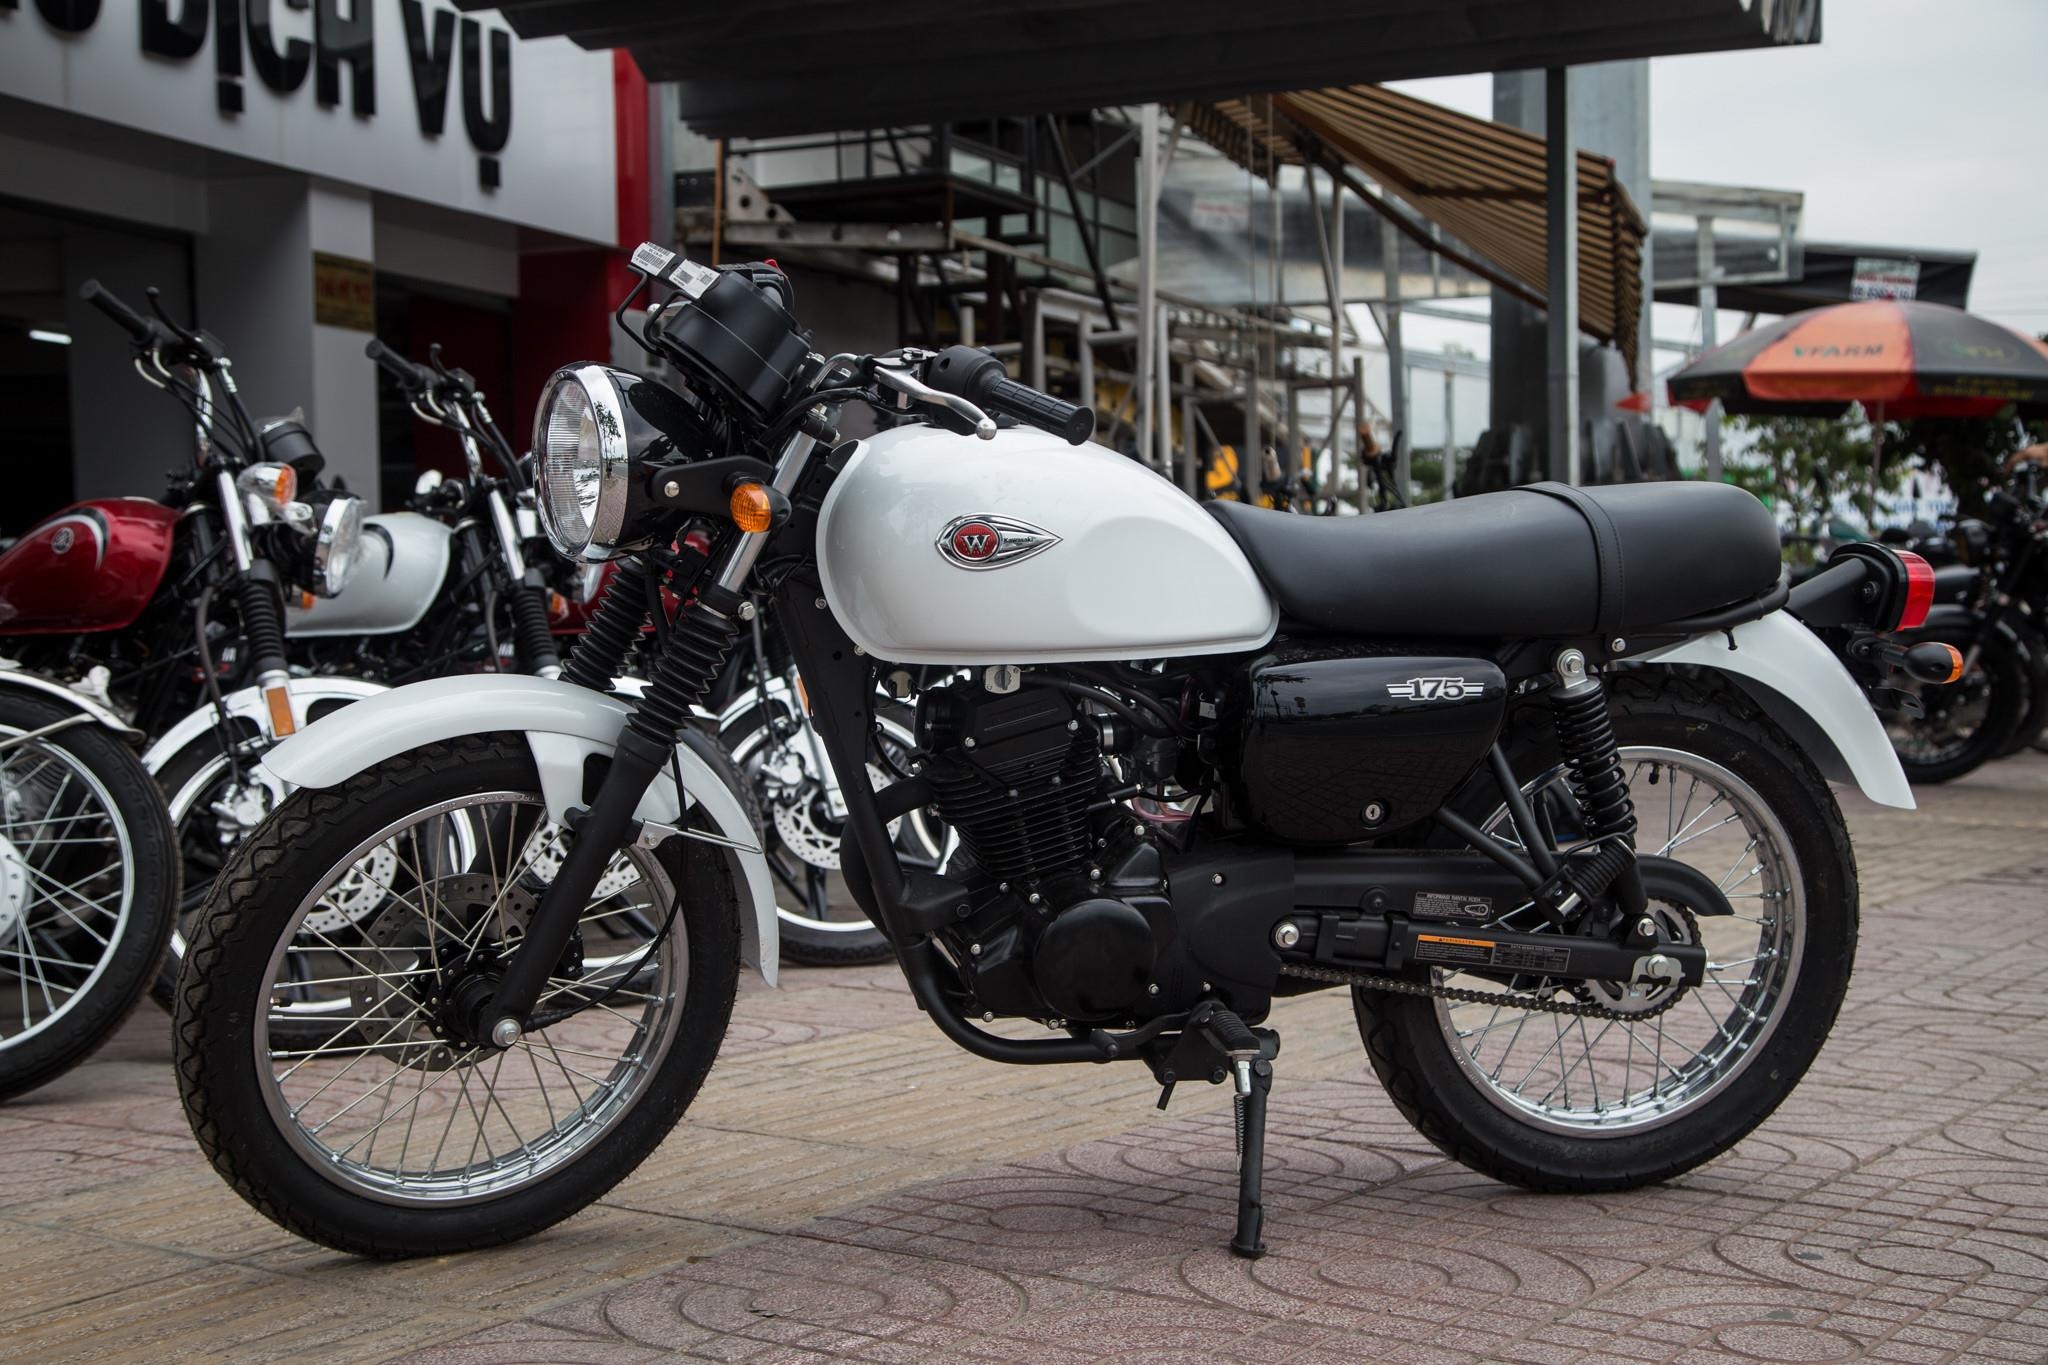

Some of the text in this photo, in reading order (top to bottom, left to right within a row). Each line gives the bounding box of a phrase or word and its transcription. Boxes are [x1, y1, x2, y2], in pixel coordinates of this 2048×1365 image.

[402, 0, 512, 188] VỤ
[961, 534, 991, 554] W
[1406, 677, 1465, 700] 175
